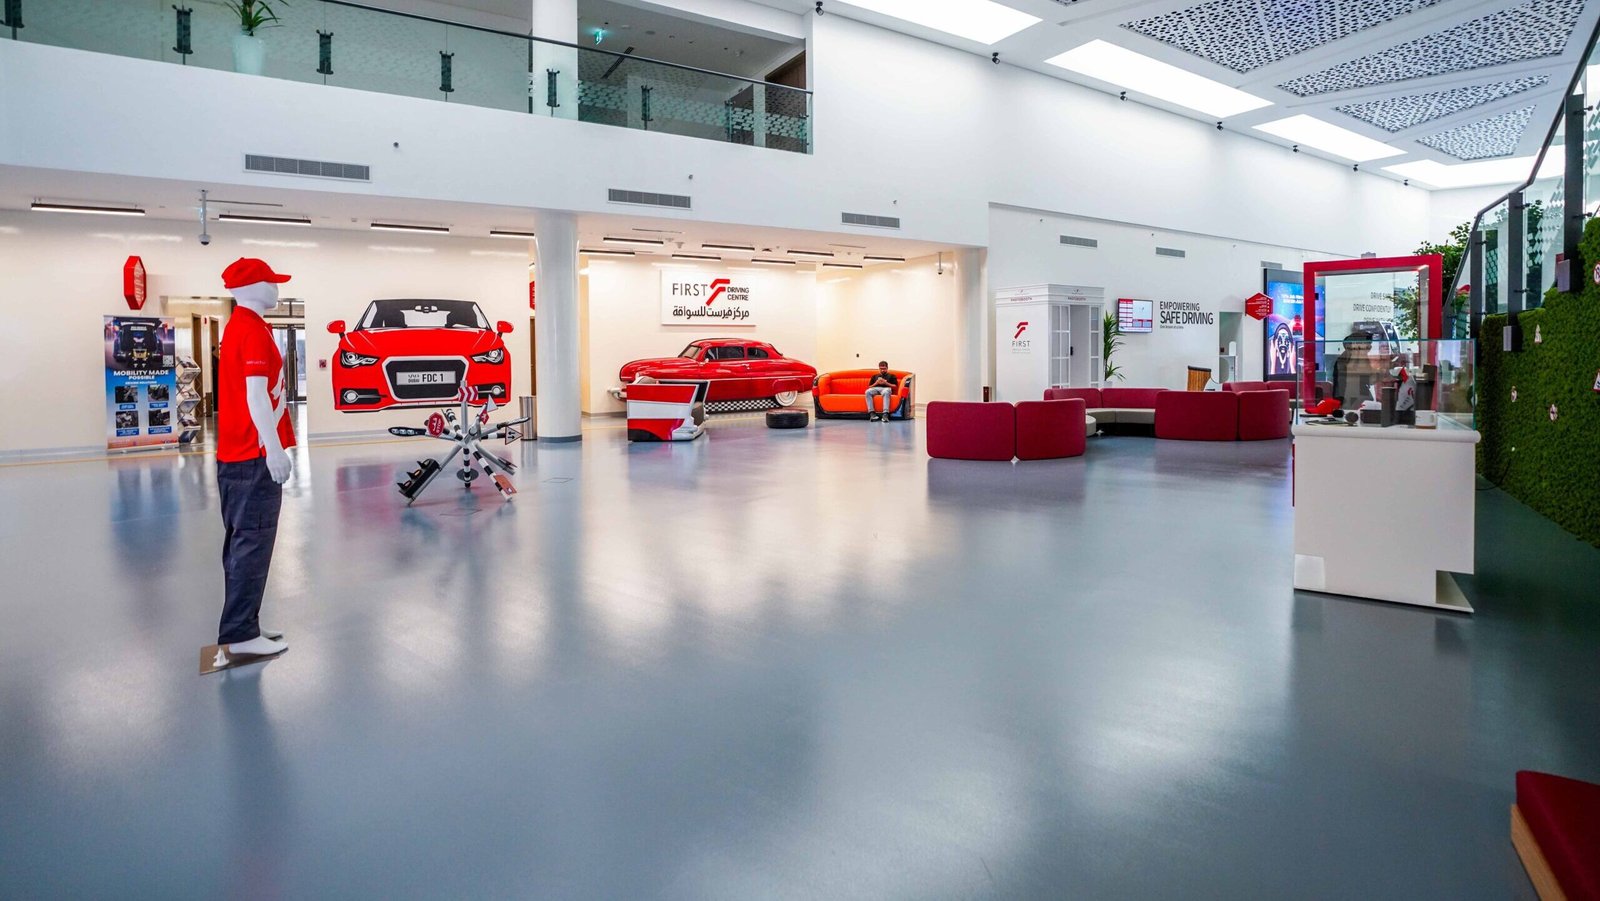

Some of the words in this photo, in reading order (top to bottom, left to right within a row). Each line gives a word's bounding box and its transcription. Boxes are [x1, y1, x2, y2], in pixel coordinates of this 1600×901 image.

[672, 283, 708, 296] FIRST
[672, 305, 706, 319] للسواقة
[1160, 301, 1200, 311] EMPOWERING
[706, 307, 733, 319] فيرست
[732, 306, 750, 320] مركز
[1160, 311, 1181, 324] SAFE
[1182, 312, 1214, 325] DRIVING
[422, 373, 437, 382] FDC
[440, 373, 444, 382] 1
